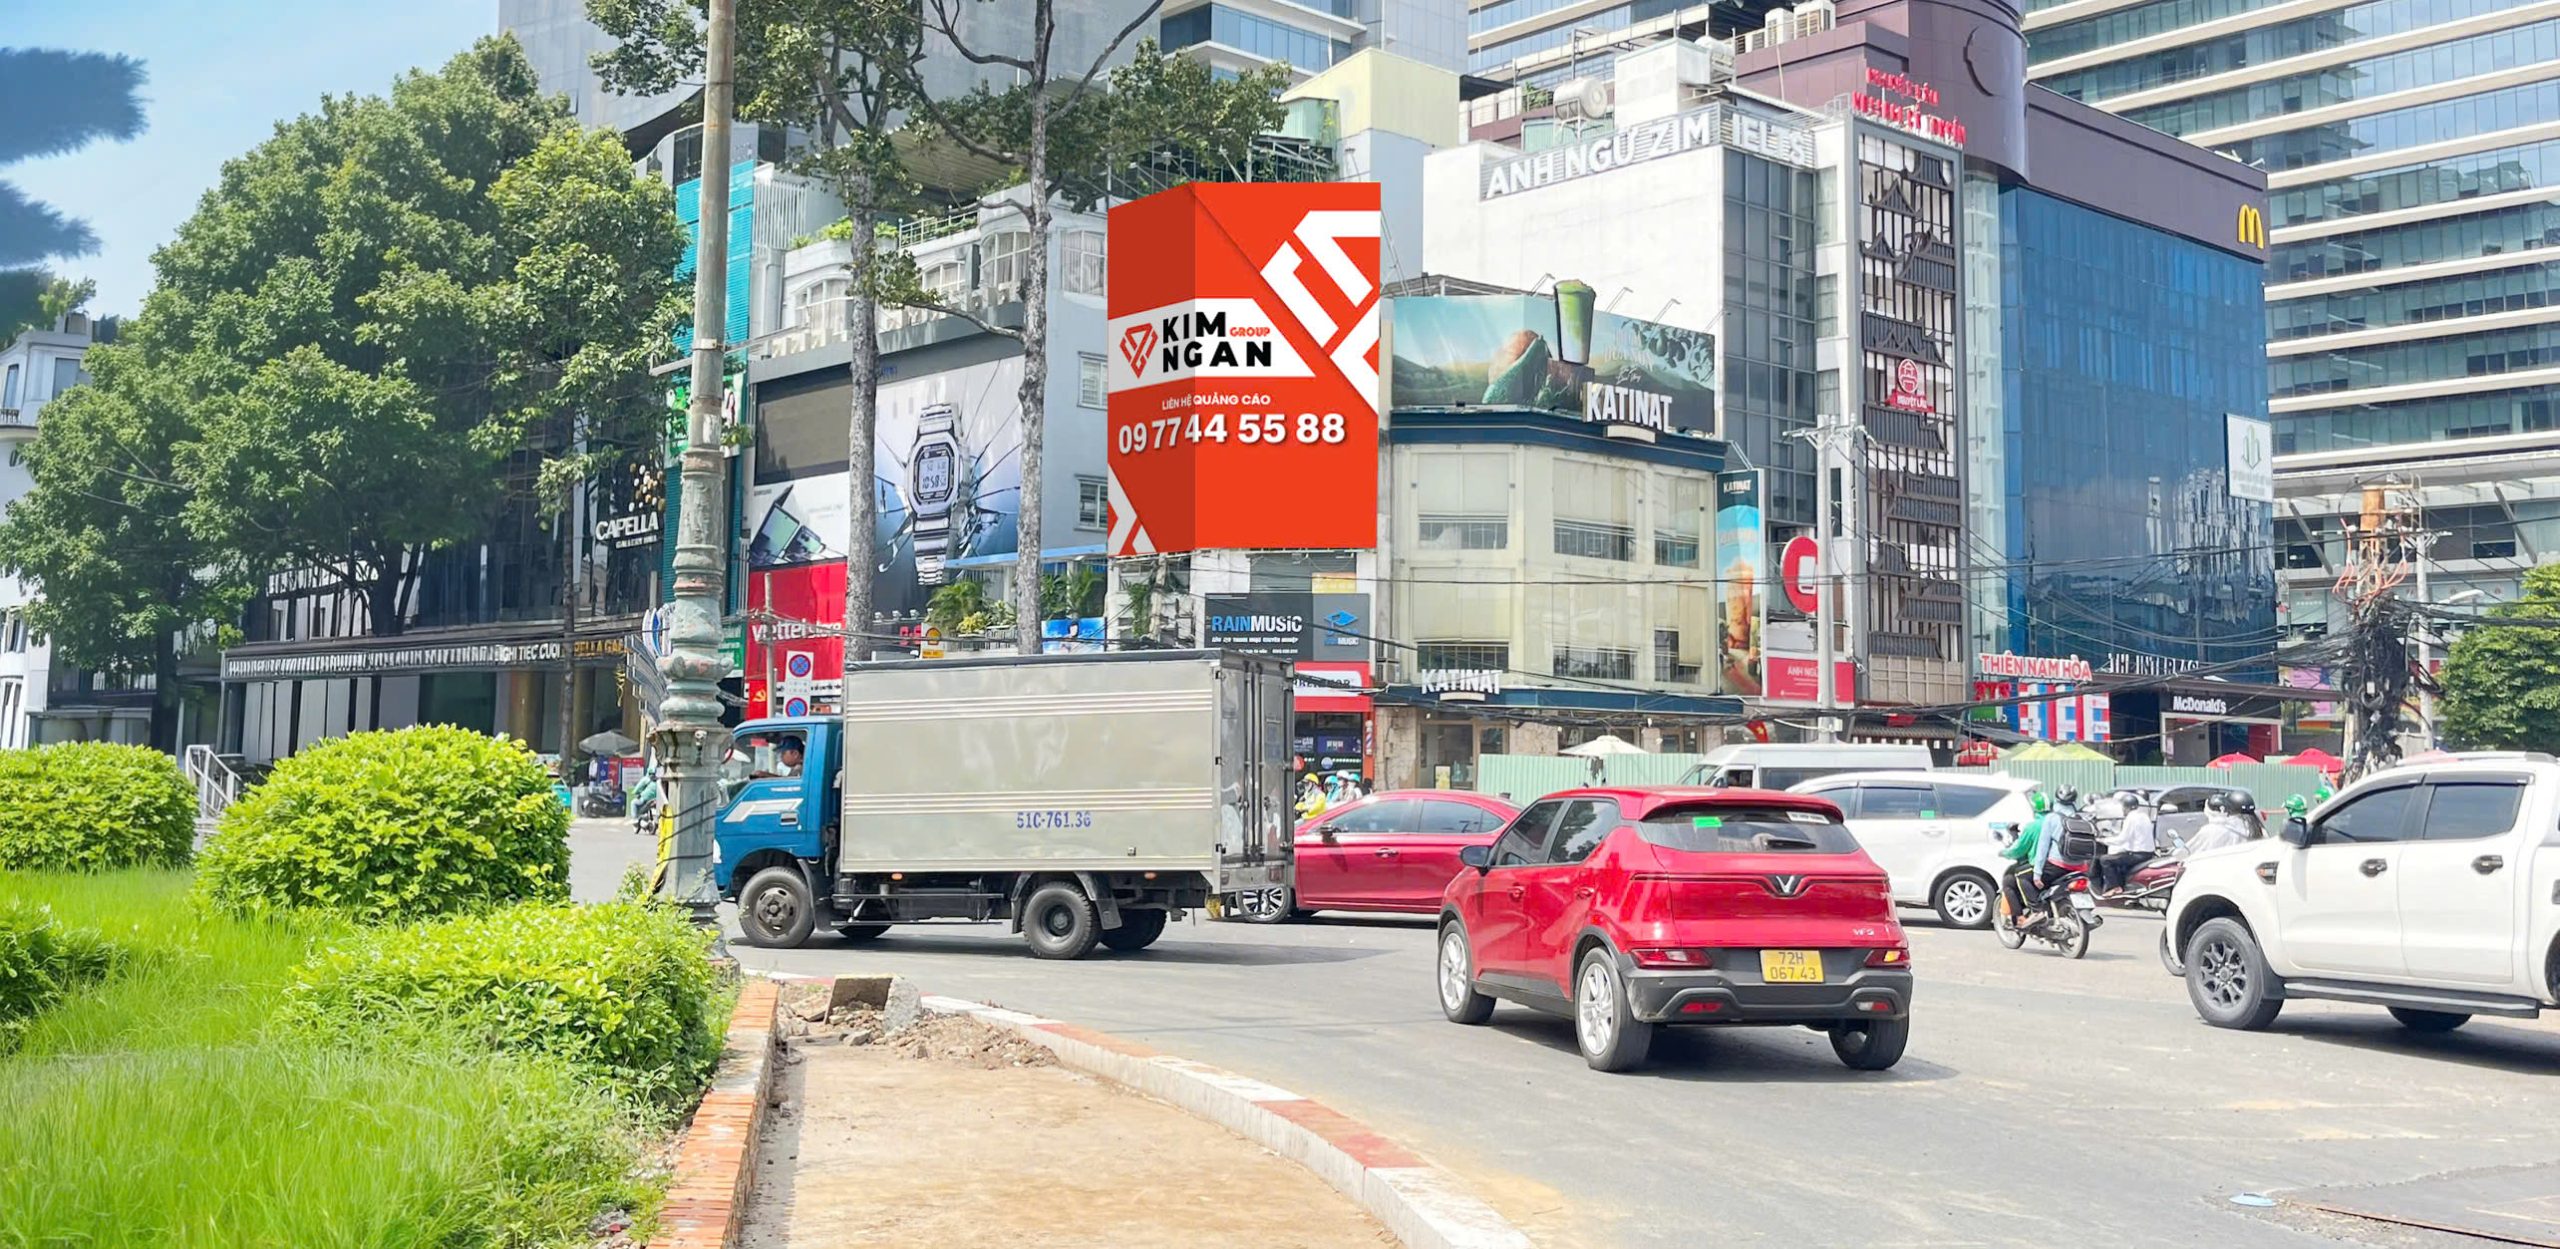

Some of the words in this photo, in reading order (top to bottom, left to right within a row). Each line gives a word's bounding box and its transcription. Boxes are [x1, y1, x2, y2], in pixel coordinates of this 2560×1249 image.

[1486, 159, 1551, 199] ANH
[1649, 112, 1711, 154] ZIM
[1731, 112, 1806, 165] IELTS
[1163, 312, 1226, 344] KIM
[1229, 327, 1271, 337] GROUP
[1163, 341, 1271, 373] NGAN
[1162, 396, 1180, 410] LIÊN
[1181, 394, 1193, 407] HỆ
[1193, 392, 1239, 406] QUẢNG
[1241, 392, 1271, 406] CÁO
[1585, 381, 1673, 433] KATINAT
[1118, 422, 1147, 454] 09
[1152, 417, 1181, 448] 77
[1184, 413, 1227, 443] 44
[1238, 413, 1286, 444] 55
[1296, 413, 1345, 444] 88
[1723, 479, 1752, 494] KATINAT
[596, 511, 659, 541] CAPELLA
[1979, 650, 2024, 676] THIÊN
[2027, 657, 2060, 678] NAM
[2062, 654, 2093, 681] HÒA
[1421, 669, 1503, 695] KATINAT
[2173, 696, 2227, 714] McDonald's
[1778, 951, 1805, 964] 72H
